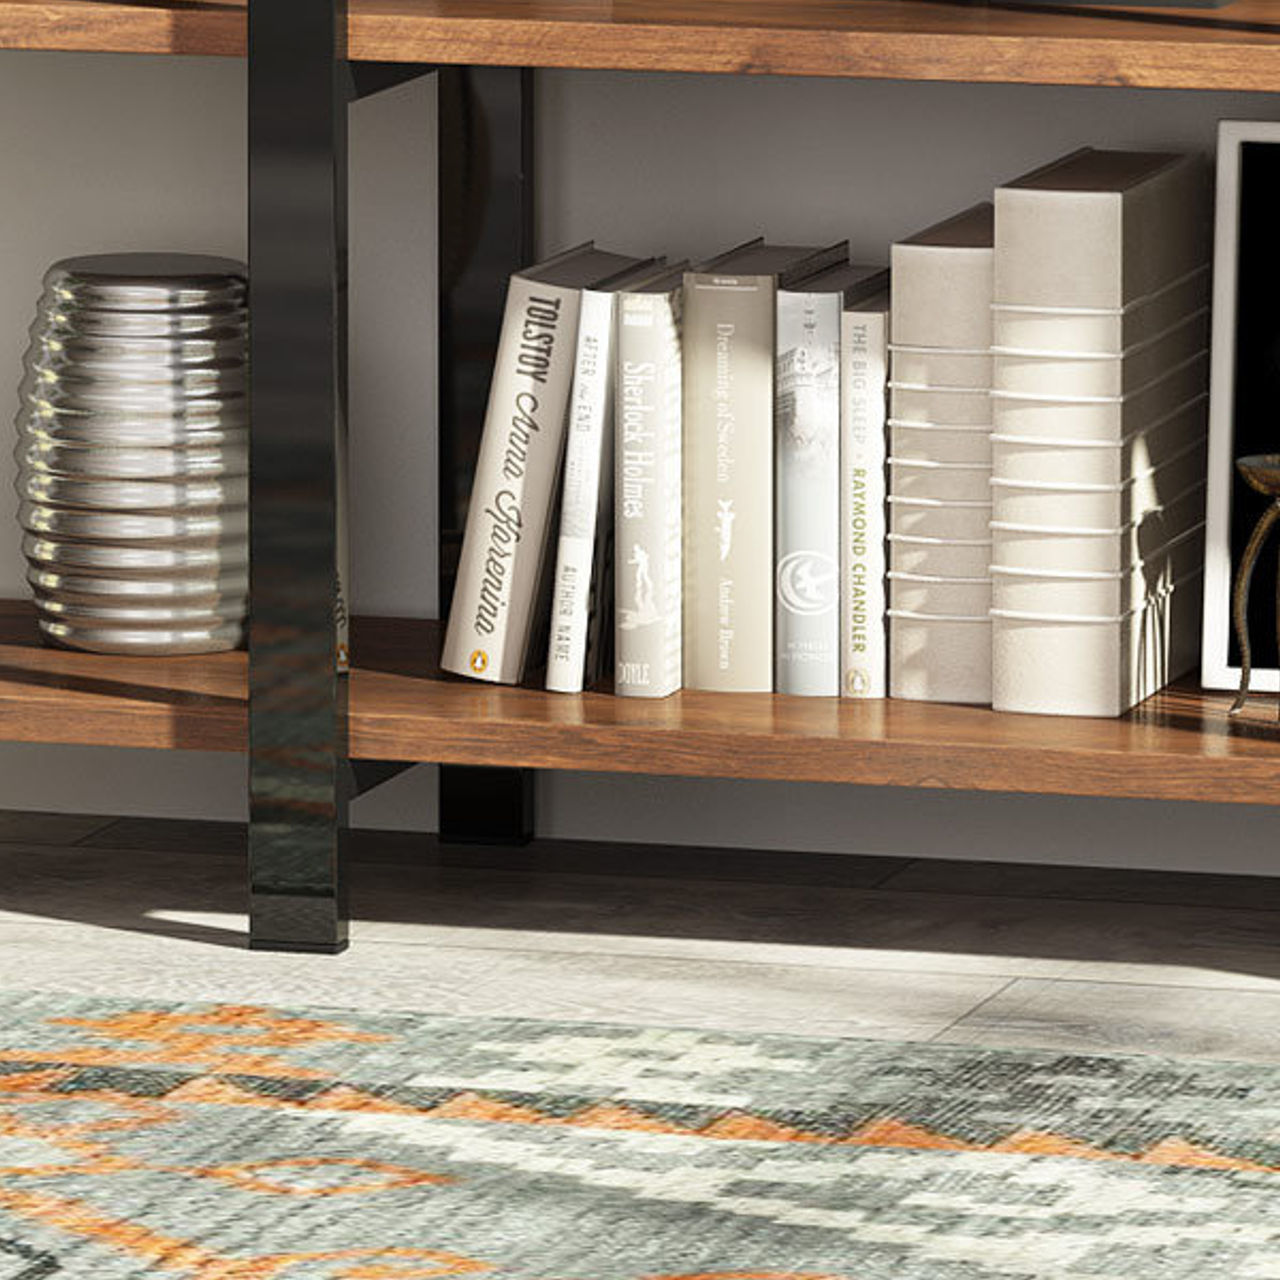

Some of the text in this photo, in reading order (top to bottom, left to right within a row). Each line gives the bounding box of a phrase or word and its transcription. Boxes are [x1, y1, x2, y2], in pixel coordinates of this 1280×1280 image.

[577, 405, 592, 432] END
[623, 361, 655, 443] Sherlock
[474, 296, 561, 636] TOLSTOY Anna Karenina
[623, 450, 654, 517] Holmes
[851, 323, 867, 653] THE BIG SLEEP RAYMOND CHANDLER
[554, 565, 578, 662] AUTHOR NAME
